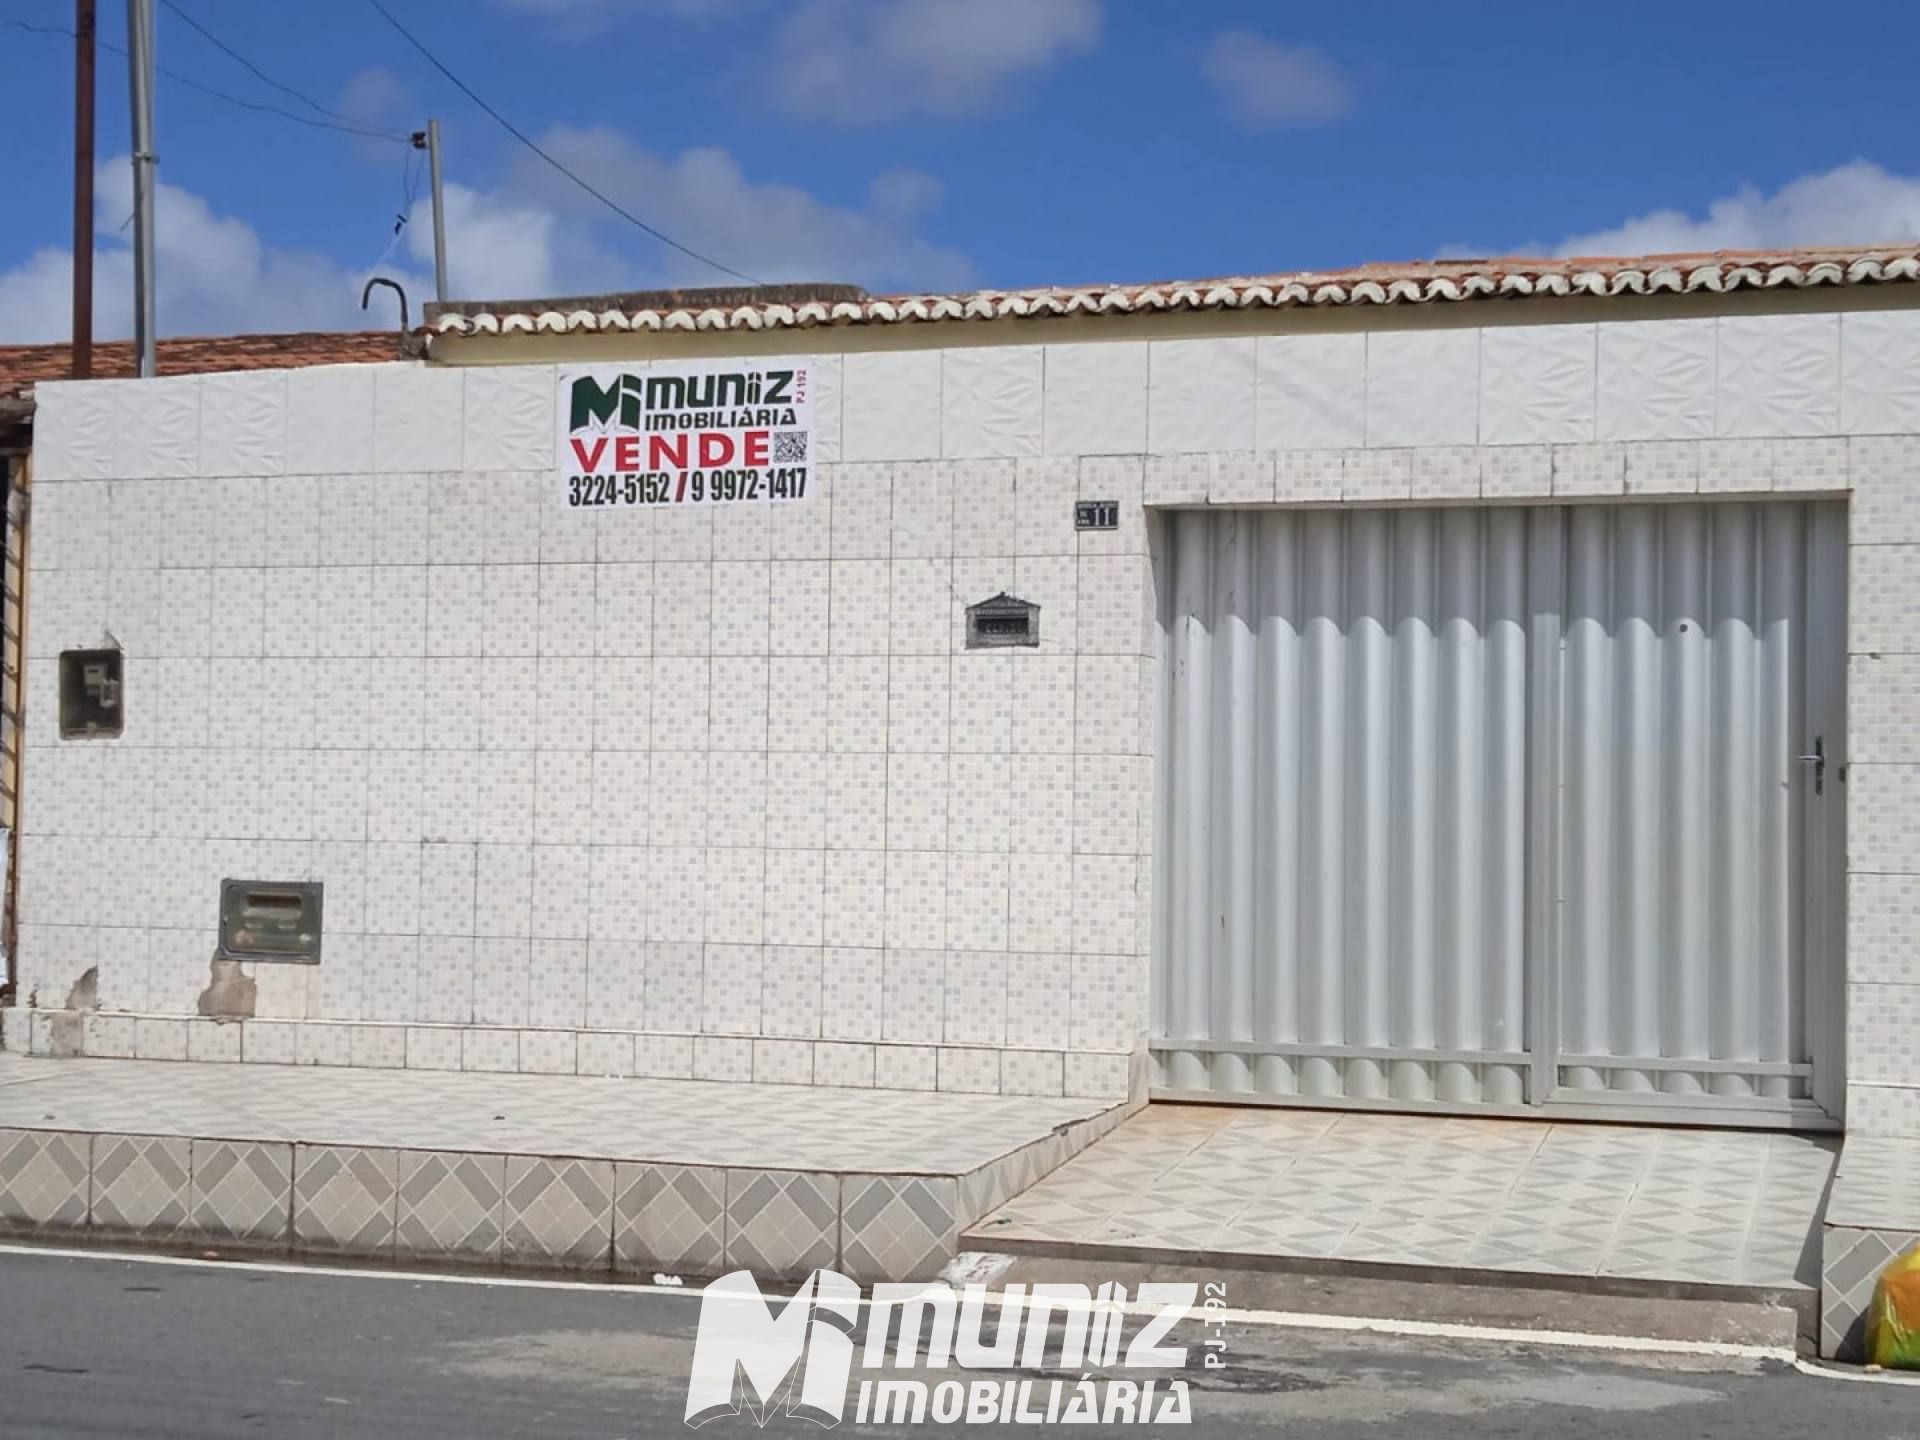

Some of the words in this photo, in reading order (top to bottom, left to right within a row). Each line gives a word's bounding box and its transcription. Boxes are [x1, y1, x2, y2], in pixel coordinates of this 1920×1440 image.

[645, 407, 797, 430] IMOBILIÁRIA
[570, 431, 769, 473] VENDE
[569, 472, 670, 507] 3224-5152
[691, 474, 704, 500] 9
[710, 467, 807, 500] 9972-1417
